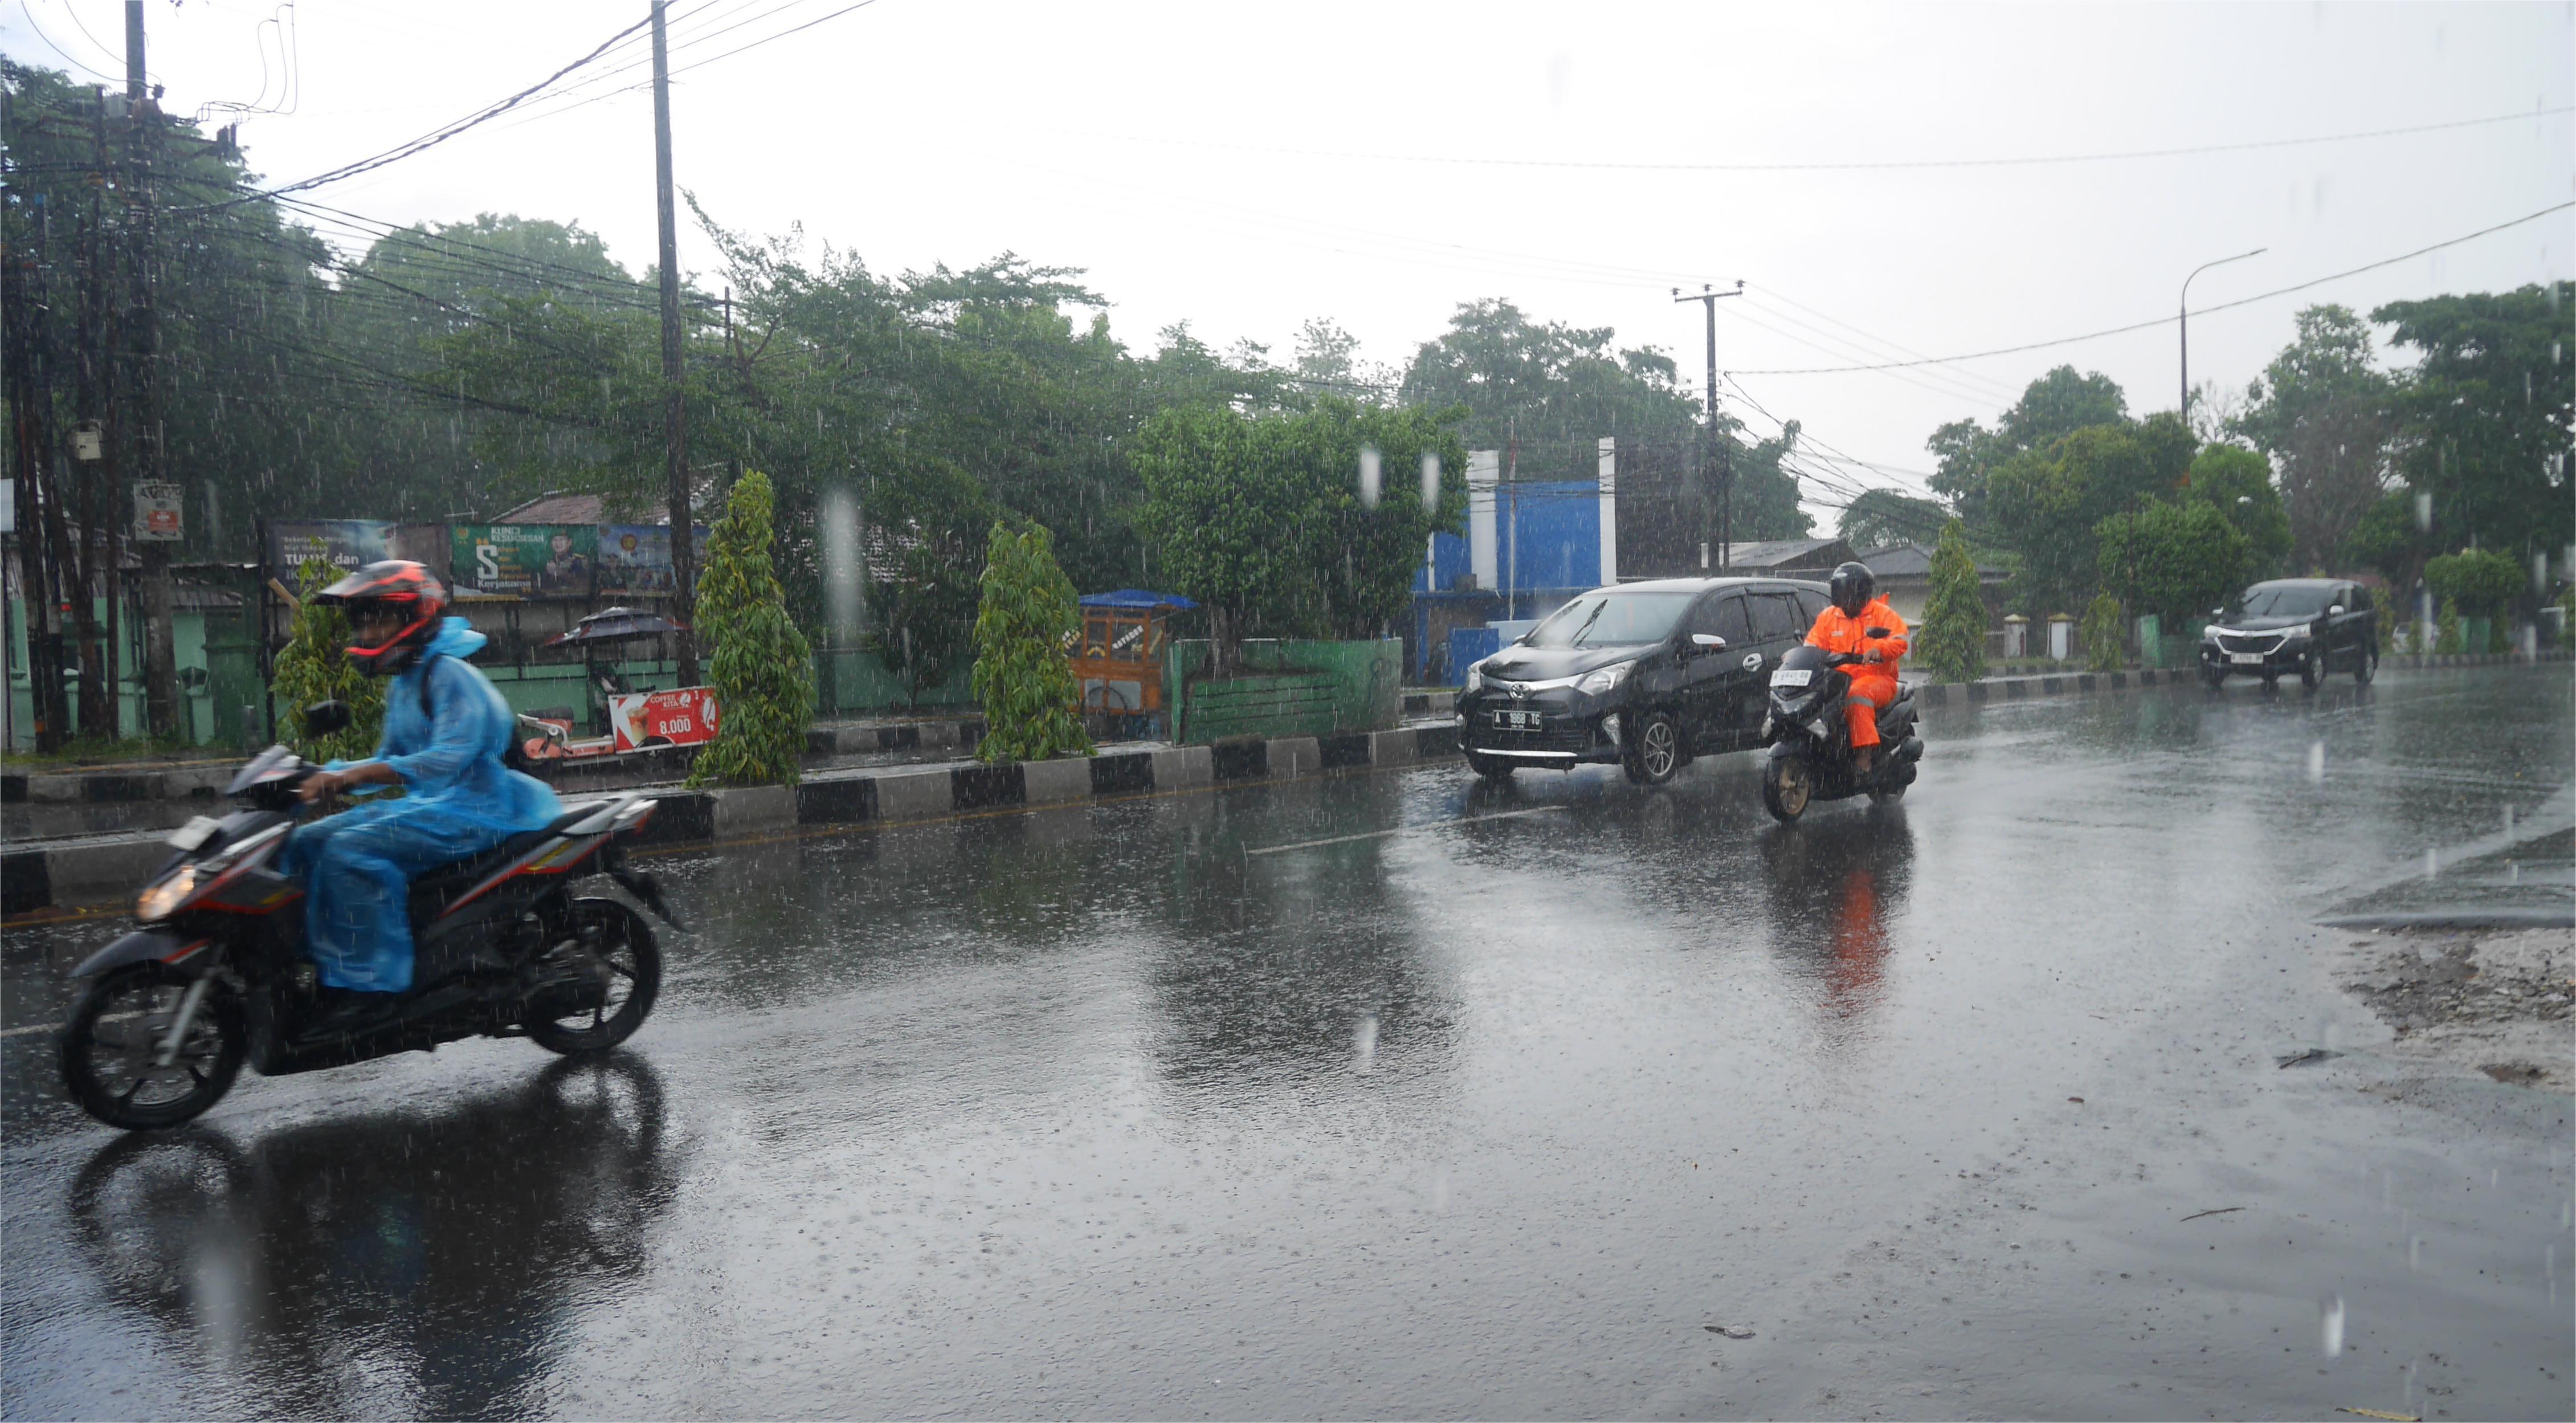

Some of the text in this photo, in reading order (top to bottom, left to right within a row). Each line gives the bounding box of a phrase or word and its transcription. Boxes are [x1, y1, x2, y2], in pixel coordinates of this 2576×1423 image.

[334, 552, 360, 564] dan
[476, 545, 499, 579] S
[650, 695, 675, 704] COFFEE
[1495, 712, 1500, 723] A
[1531, 713, 1540, 725] TG
[659, 718, 691, 735] 8.000
